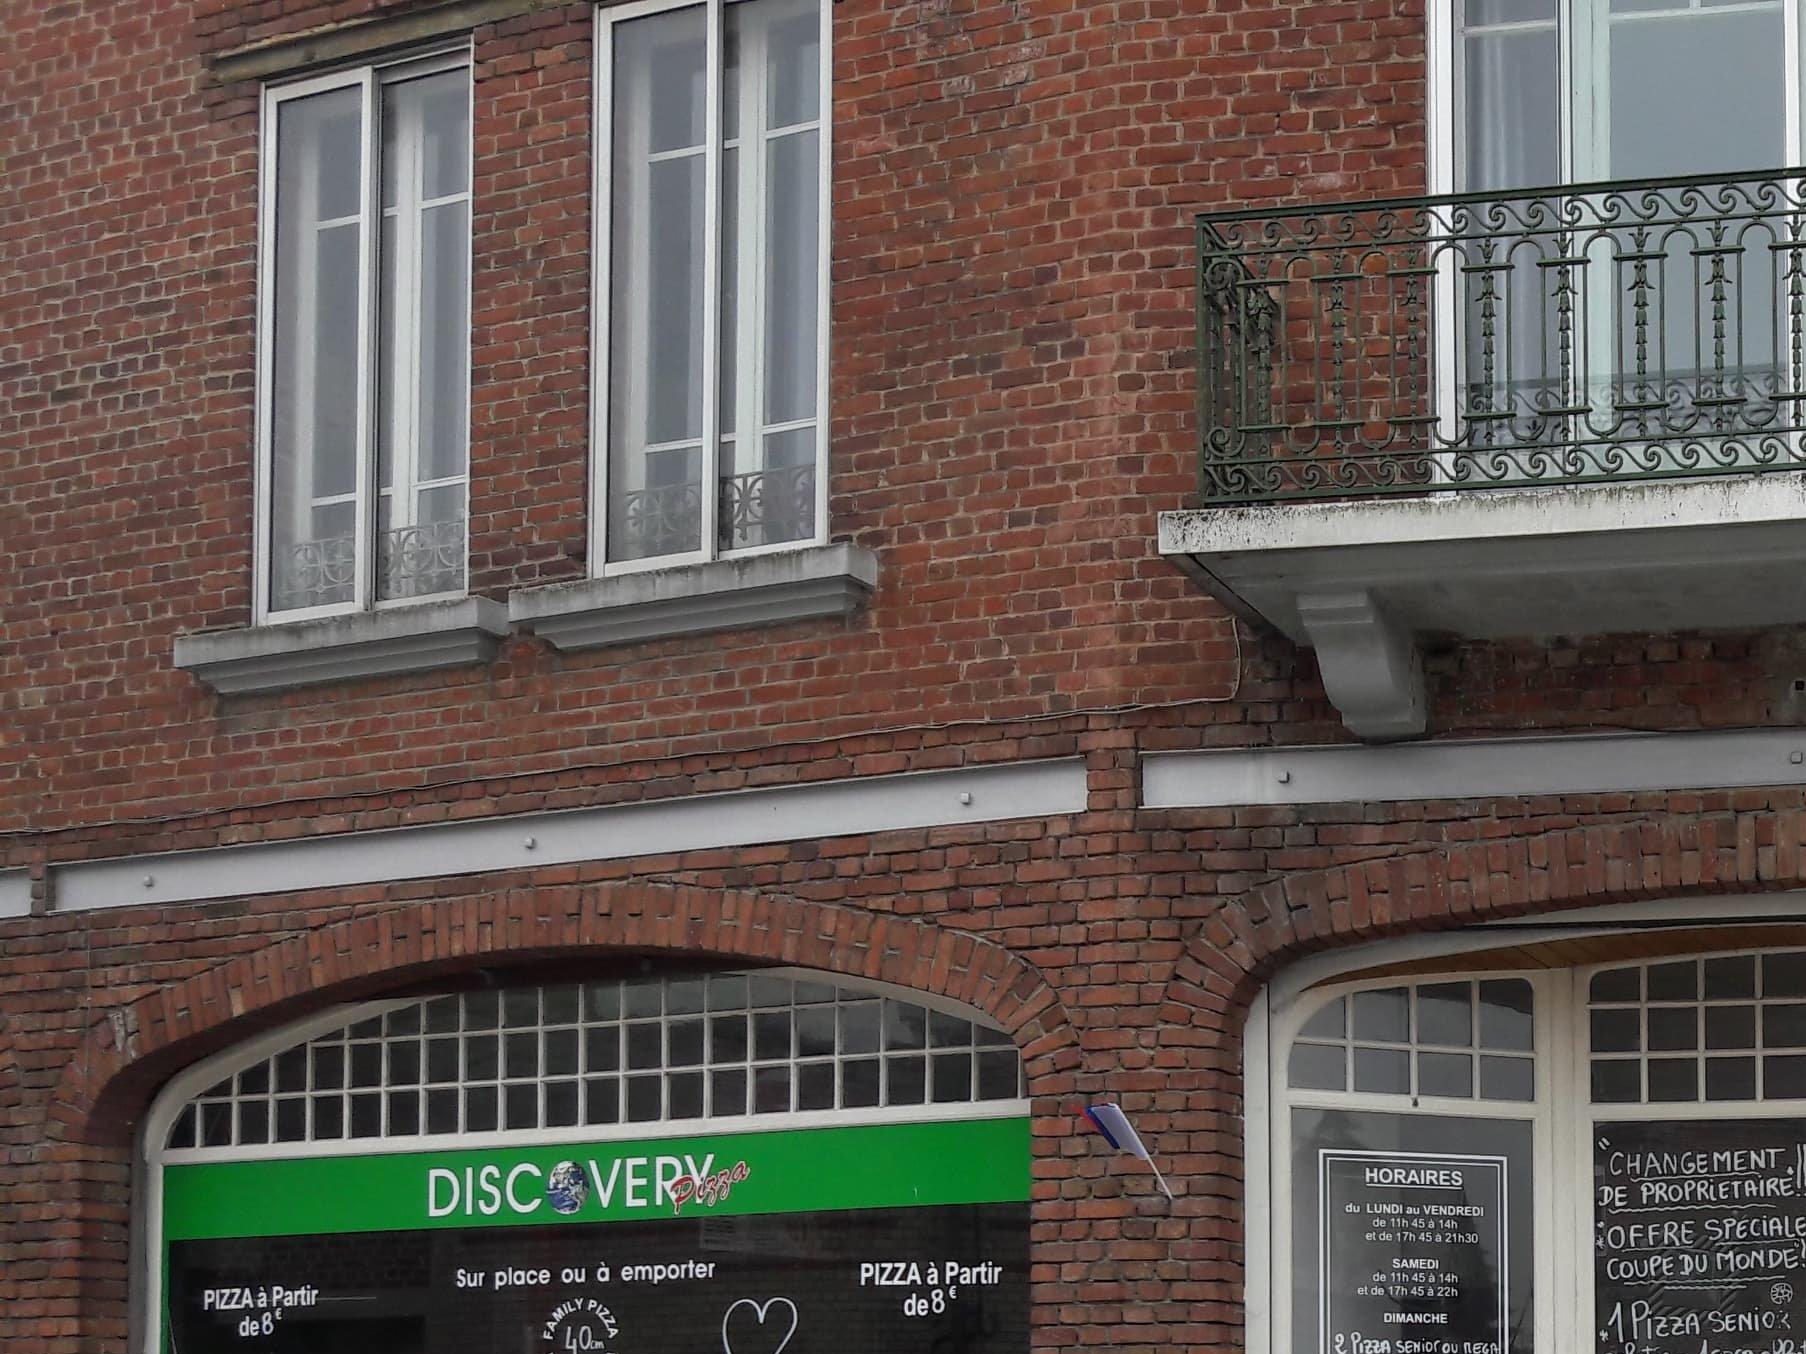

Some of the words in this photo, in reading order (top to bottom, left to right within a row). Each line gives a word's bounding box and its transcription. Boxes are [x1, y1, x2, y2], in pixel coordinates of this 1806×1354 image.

[671, 1160, 750, 1216] Pizza
[1365, 1168, 1463, 1186] HORAIRES
[1598, 1185, 1628, 1207] DE
[1345, 1203, 1360, 1213] du
[1366, 1204, 1403, 1215] LUNDI
[1406, 1206, 1420, 1215] au
[1423, 1205, 1484, 1217] VENDREDI
[456, 1268, 485, 1288] Sur
[494, 1267, 550, 1290] place
[561, 1267, 586, 1284] ou
[597, 1261, 610, 1283] à
[621, 1260, 715, 1284] emporter
[860, 1262, 922, 1286] PIZZA
[926, 1262, 938, 1285] à
[945, 1261, 1002, 1285] Partir
[1392, 1258, 1439, 1270] SAMEDI
[1606, 1254, 1674, 1280] COUPE
[1679, 1253, 1708, 1276] DU
[203, 1288, 254, 1311] PIZZA
[257, 1286, 267, 1308] à
[272, 1285, 319, 1308] Partir
[904, 1293, 929, 1316] de
[239, 1316, 259, 1337] de
[543, 1298, 584, 1340] FAMILY
[587, 1299, 619, 1339] PIZZA
[1384, 1312, 1448, 1324] DIMANCHE
[1608, 1301, 1624, 1343] 1
[1334, 1333, 1347, 1354] 2
